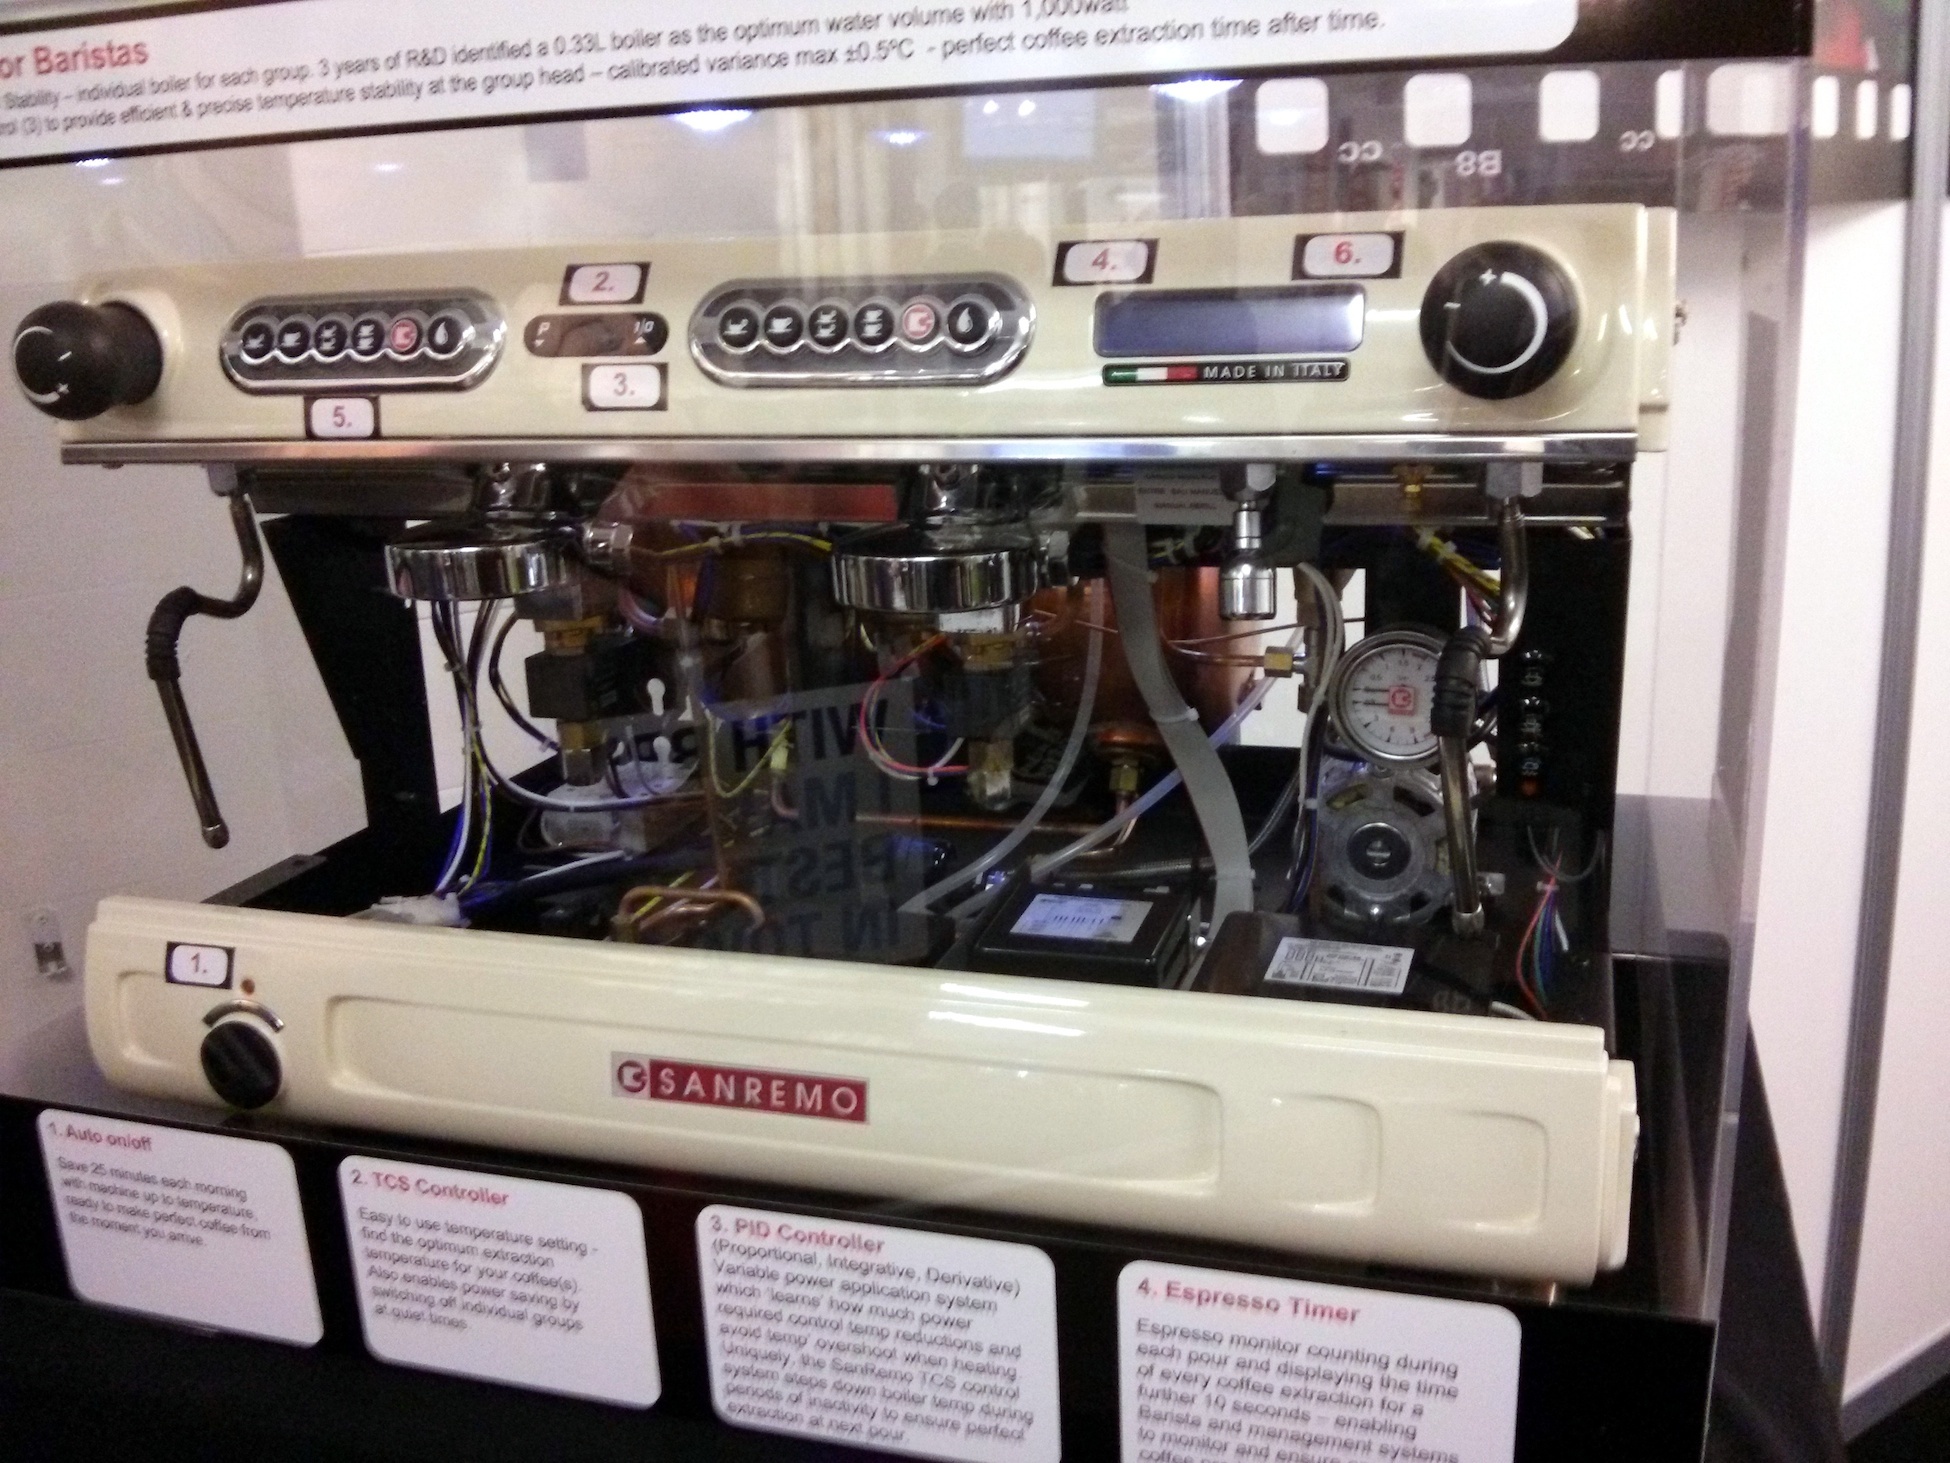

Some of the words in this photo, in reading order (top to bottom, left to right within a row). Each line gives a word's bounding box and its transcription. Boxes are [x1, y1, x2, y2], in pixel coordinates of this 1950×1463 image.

[33, 40, 149, 75] Baristas
[195, 70, 215, 90] for
[220, 66, 258, 87] each
[318, 57, 330, 77] 3
[335, 55, 380, 79] years
[384, 51, 400, 71] of
[405, 45, 447, 68] R&D
[452, 39, 532, 64] identified
[537, 41, 549, 57] a
[610, 28, 662, 50] boiler
[668, 27, 692, 46] as
[697, 22, 728, 43] the
[734, 17, 820, 45] optimum
[825, 12, 883, 33] water
[890, 5, 965, 28] volume
[970, 0, 1014, 23] with
[62, 109, 116, 133] provide
[197, 97, 253, 119] precise
[257, 84, 354, 110] temperature
[359, 76, 424, 100] stability
[428, 74, 447, 94] at
[450, 72, 478, 93] the
[482, 72, 535, 96] group
[537, 62, 585, 85] head
[608, 54, 701, 81] calibrated
[706, 49, 789, 73] variance
[795, 46, 838, 67] max
[942, 31, 1015, 61] perfect
[1021, 25, 1088, 51] coffee
[1095, 18, 1205, 46] extraction
[1211, 14, 1261, 39] time
[1267, 10, 1322, 36] after
[1328, 8, 1387, 32] time.
[1091, 247, 1118, 271] 4.
[1333, 240, 1362, 265] 6.
[591, 270, 615, 292] 2.
[613, 371, 635, 397] 3.
[1203, 365, 1256, 380] MADE
[1264, 364, 1285, 378] IN
[1292, 361, 1346, 377] ITALY
[332, 406, 353, 428] 5.
[190, 952, 208, 975] 1.
[658, 1066, 858, 1116] SANREMO
[66, 1123, 103, 1144] Auto
[57, 1156, 89, 1173] Save
[90, 1162, 107, 1176] 25
[110, 1167, 158, 1185] minutes
[195, 1181, 248, 1203] morning
[350, 1168, 368, 1186] 2.
[373, 1171, 411, 1192] TCS
[415, 1178, 510, 1206] Controller
[241, 1223, 271, 1241] from
[358, 1206, 393, 1228] Easy
[397, 1212, 412, 1227] to
[416, 1218, 441, 1232] use
[444, 1220, 534, 1246] temperature
[537, 1235, 588, 1258] setting
[361, 1226, 387, 1242] find
[390, 1230, 414, 1247] the
[417, 1236, 480, 1256] optimum
[483, 1246, 555, 1268] extraction
[710, 1214, 729, 1234] 3.
[735, 1217, 771, 1238] PID
[777, 1223, 886, 1253] Controller
[453, 1259, 472, 1274] for
[476, 1266, 509, 1281] your
[712, 1258, 780, 1281] Variable
[785, 1272, 836, 1289] power
[840, 1278, 931, 1303] application
[936, 1291, 998, 1313] system
[926, 1266, 1022, 1299] Derivative)
[402, 1273, 459, 1292] enables
[462, 1282, 506, 1298] power
[510, 1289, 558, 1310] saving
[562, 1296, 580, 1315] by
[716, 1281, 762, 1299] which
[829, 1295, 865, 1314] how
[869, 1303, 915, 1322] much
[920, 1311, 974, 1330] power
[1136, 1276, 1158, 1297] 4.
[1165, 1279, 1281, 1313] Espresso
[1288, 1295, 1361, 1323] Timer
[532, 1312, 584, 1331] groups
[717, 1301, 783, 1324] required
[787, 1311, 844, 1332] control
[848, 1320, 891, 1341] temp
[895, 1325, 984, 1353] reductions
[988, 1343, 1022, 1361] and
[719, 1322, 762, 1339] avoid
[815, 1336, 898, 1361] overshoot
[904, 1350, 949, 1368] when
[1136, 1317, 1224, 1345] Espresso
[1229, 1332, 1302, 1355] monitor
[1306, 1343, 1391, 1371] counting
[1396, 1353, 1459, 1380] during
[800, 1352, 827, 1370] the
[831, 1356, 914, 1384] SanRemo
[918, 1369, 957, 1391] TCS
[960, 1380, 1020, 1401] control
[1136, 1342, 1182, 1361] each
[1187, 1350, 1230, 1368] pour
[1235, 1356, 1271, 1374] and
[1276, 1360, 1374, 1393] displaying
[1379, 1373, 1411, 1394] the
[1415, 1379, 1459, 1400] time
[1136, 1363, 1155, 1378] of
[1160, 1367, 1211, 1391] every
[1216, 1375, 1275, 1396] coffee
[1280, 1384, 1374, 1410] extraction
[1379, 1396, 1407, 1414] for
[1411, 1402, 1424, 1418] a
[722, 1361, 780, 1380] system
[783, 1370, 829, 1391] steps
[831, 1379, 878, 1398] down
[881, 1386, 928, 1405] boiler
[931, 1393, 976, 1415] temp
[979, 1402, 1034, 1427] during
[1136, 1383, 1198, 1405] further
[1204, 1393, 1227, 1412] 10
[1230, 1399, 1312, 1423] seconds
[1334, 1414, 1418, 1442] enabling
[726, 1400, 804, 1424] extraction
[808, 1414, 824, 1429] at
[828, 1418, 863, 1434] next
[787, 1390, 803, 1405] of
[807, 1396, 879, 1422] inactivity
[881, 1405, 900, 1422] to
[902, 1410, 962, 1433] ensure
[965, 1420, 1025, 1442] perfect
[1138, 1403, 1202, 1429] Barista
[1207, 1417, 1243, 1434] and
[1248, 1423, 1373, 1453] management
[1378, 1441, 1460, 1463] systems
[1138, 1425, 1156, 1443] to
[1160, 1431, 1231, 1453] monitor
[1235, 1442, 1270, 1460] and
